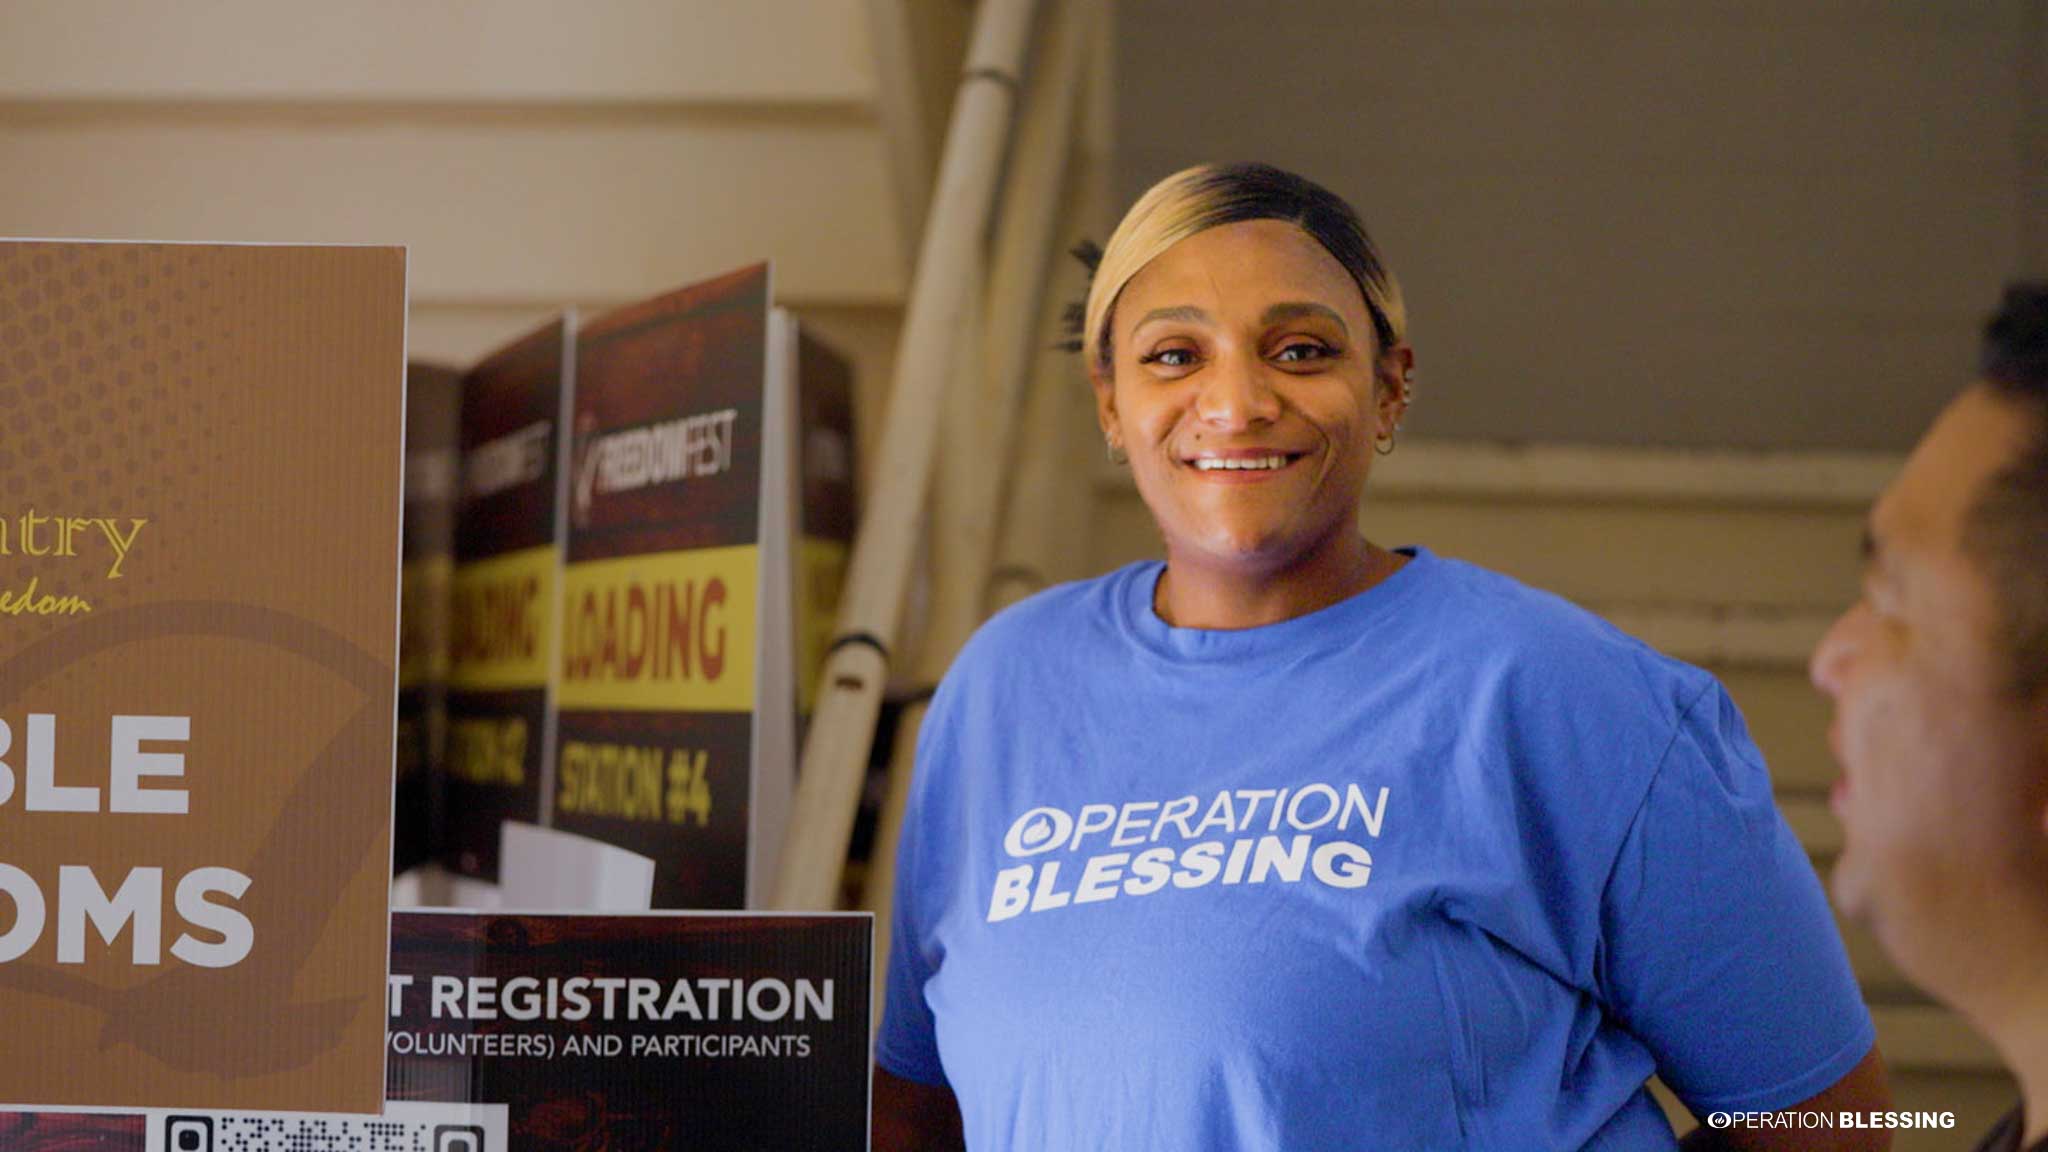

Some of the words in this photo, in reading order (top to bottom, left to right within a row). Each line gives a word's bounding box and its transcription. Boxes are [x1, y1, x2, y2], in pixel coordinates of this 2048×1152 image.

[566, 576, 726, 683] LOADING
[0, 712, 191, 814] LE
[560, 741, 664, 822] STATION
[667, 748, 712, 827] #4
[1003, 783, 1390, 858] OPERATION
[986, 835, 1373, 923] BLESSING
[431, 976, 834, 1021] REGISTRATION
[562, 1034, 623, 1057] AND
[631, 1034, 811, 1058] PARTICIPANTS
